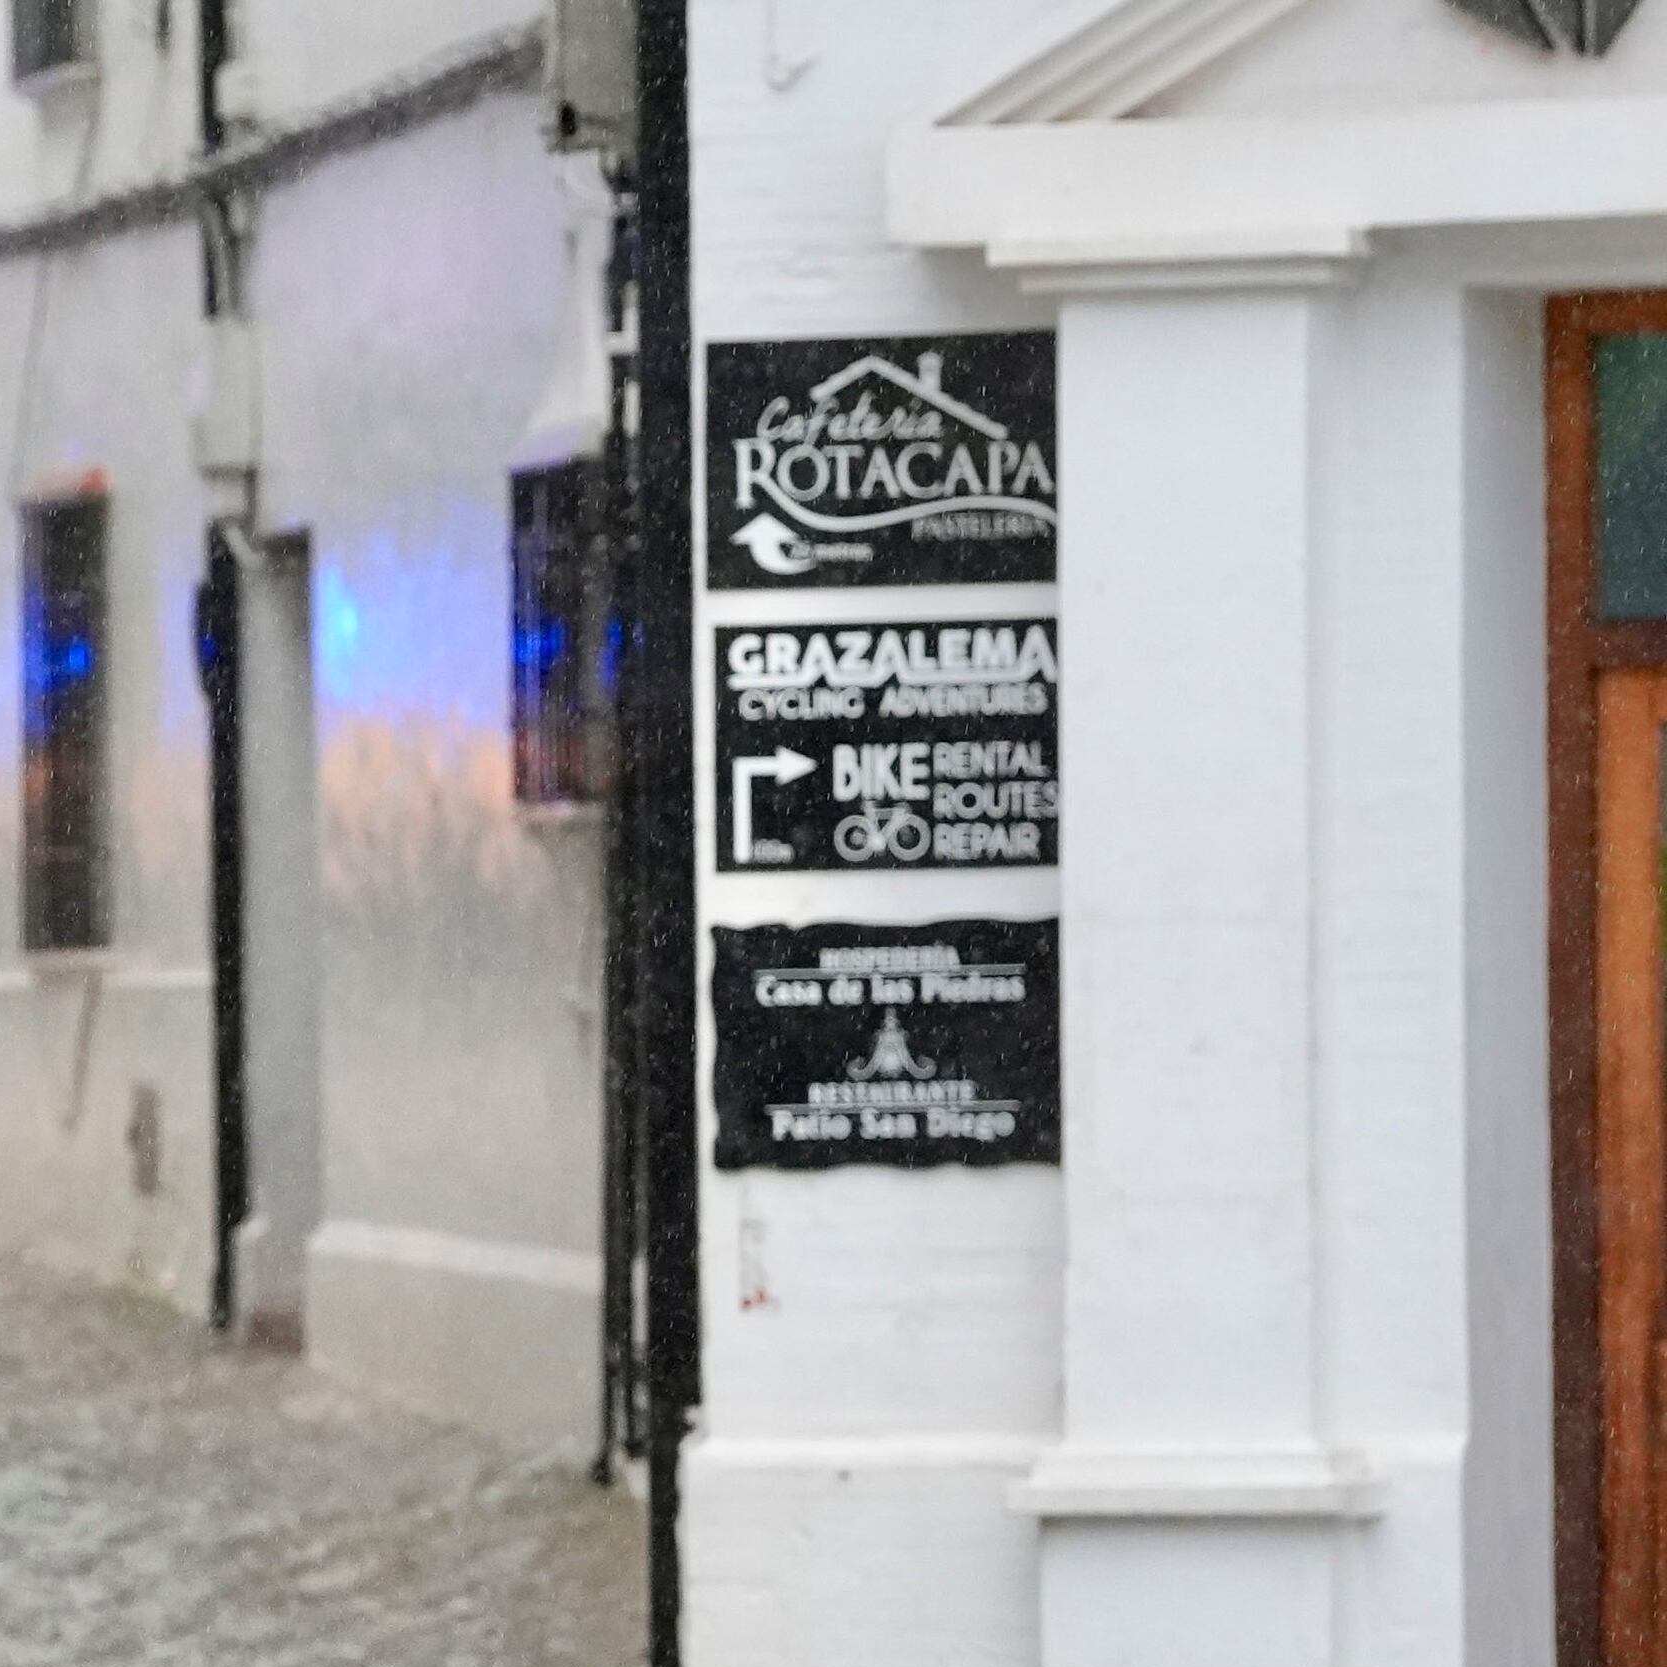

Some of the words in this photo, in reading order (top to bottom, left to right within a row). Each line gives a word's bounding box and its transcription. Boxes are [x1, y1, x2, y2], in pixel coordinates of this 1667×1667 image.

[734, 437, 1053, 510] ROTACAPA
[727, 624, 1056, 688] GRAZALEMA
[738, 686, 865, 721] CYCLING
[878, 682, 1049, 718] ADVENTURES
[832, 742, 931, 801] BIKE
[933, 741, 1048, 779] RENTAL
[933, 780, 1058, 819] ROUTES
[933, 822, 1041, 861] REPAIR
[756, 975, 822, 1007] Casa
[828, 975, 864, 1005] de
[871, 974, 915, 1004] las
[921, 971, 1026, 1003] Piedras
[772, 1109, 852, 1141] Patio
[860, 1107, 916, 1139] San
[927, 1106, 1016, 1142] Diego
